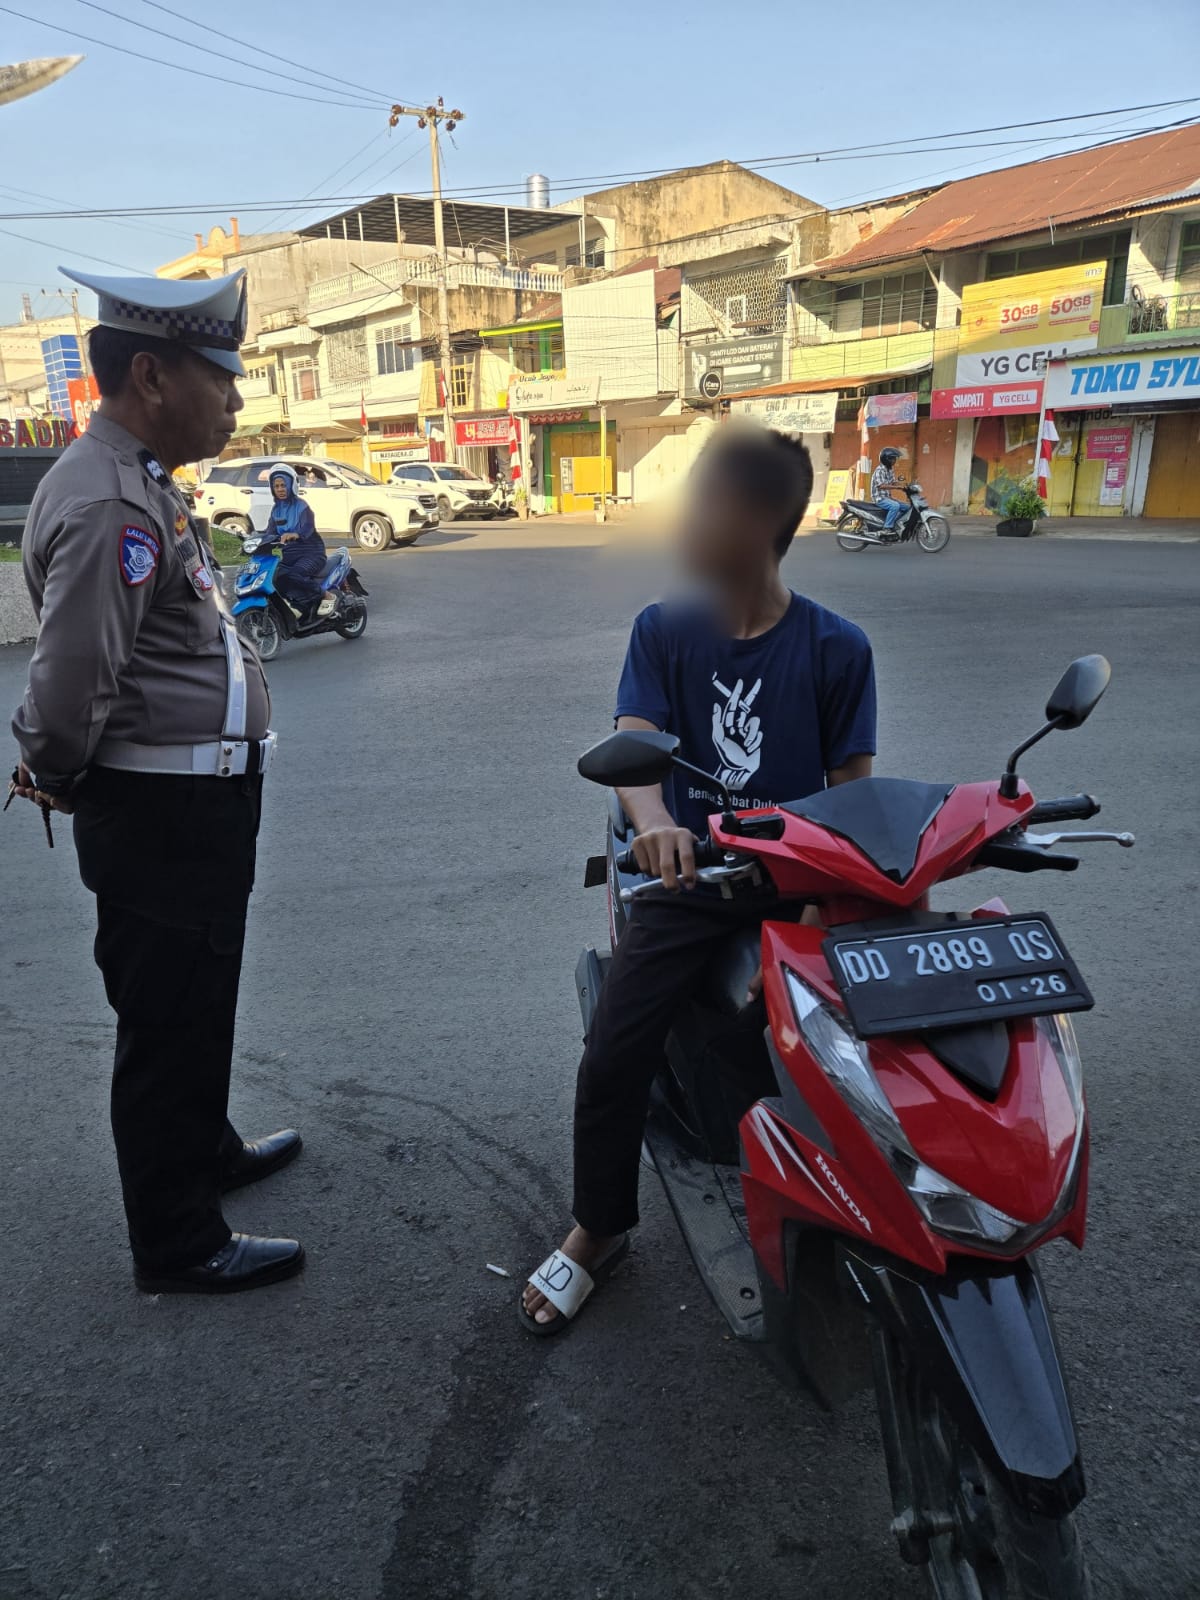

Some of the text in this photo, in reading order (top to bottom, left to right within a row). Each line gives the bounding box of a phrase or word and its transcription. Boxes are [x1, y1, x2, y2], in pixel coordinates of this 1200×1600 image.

[981, 356, 1010, 377] YG
[1070, 361, 1141, 395] TOKO
[952, 391, 1031, 409] SIMPATI YG CELL
[717, 793, 750, 808] Sbat
[842, 930, 1054, 984] DD 2889 QS
[814, 1152, 873, 1234] HONDA
